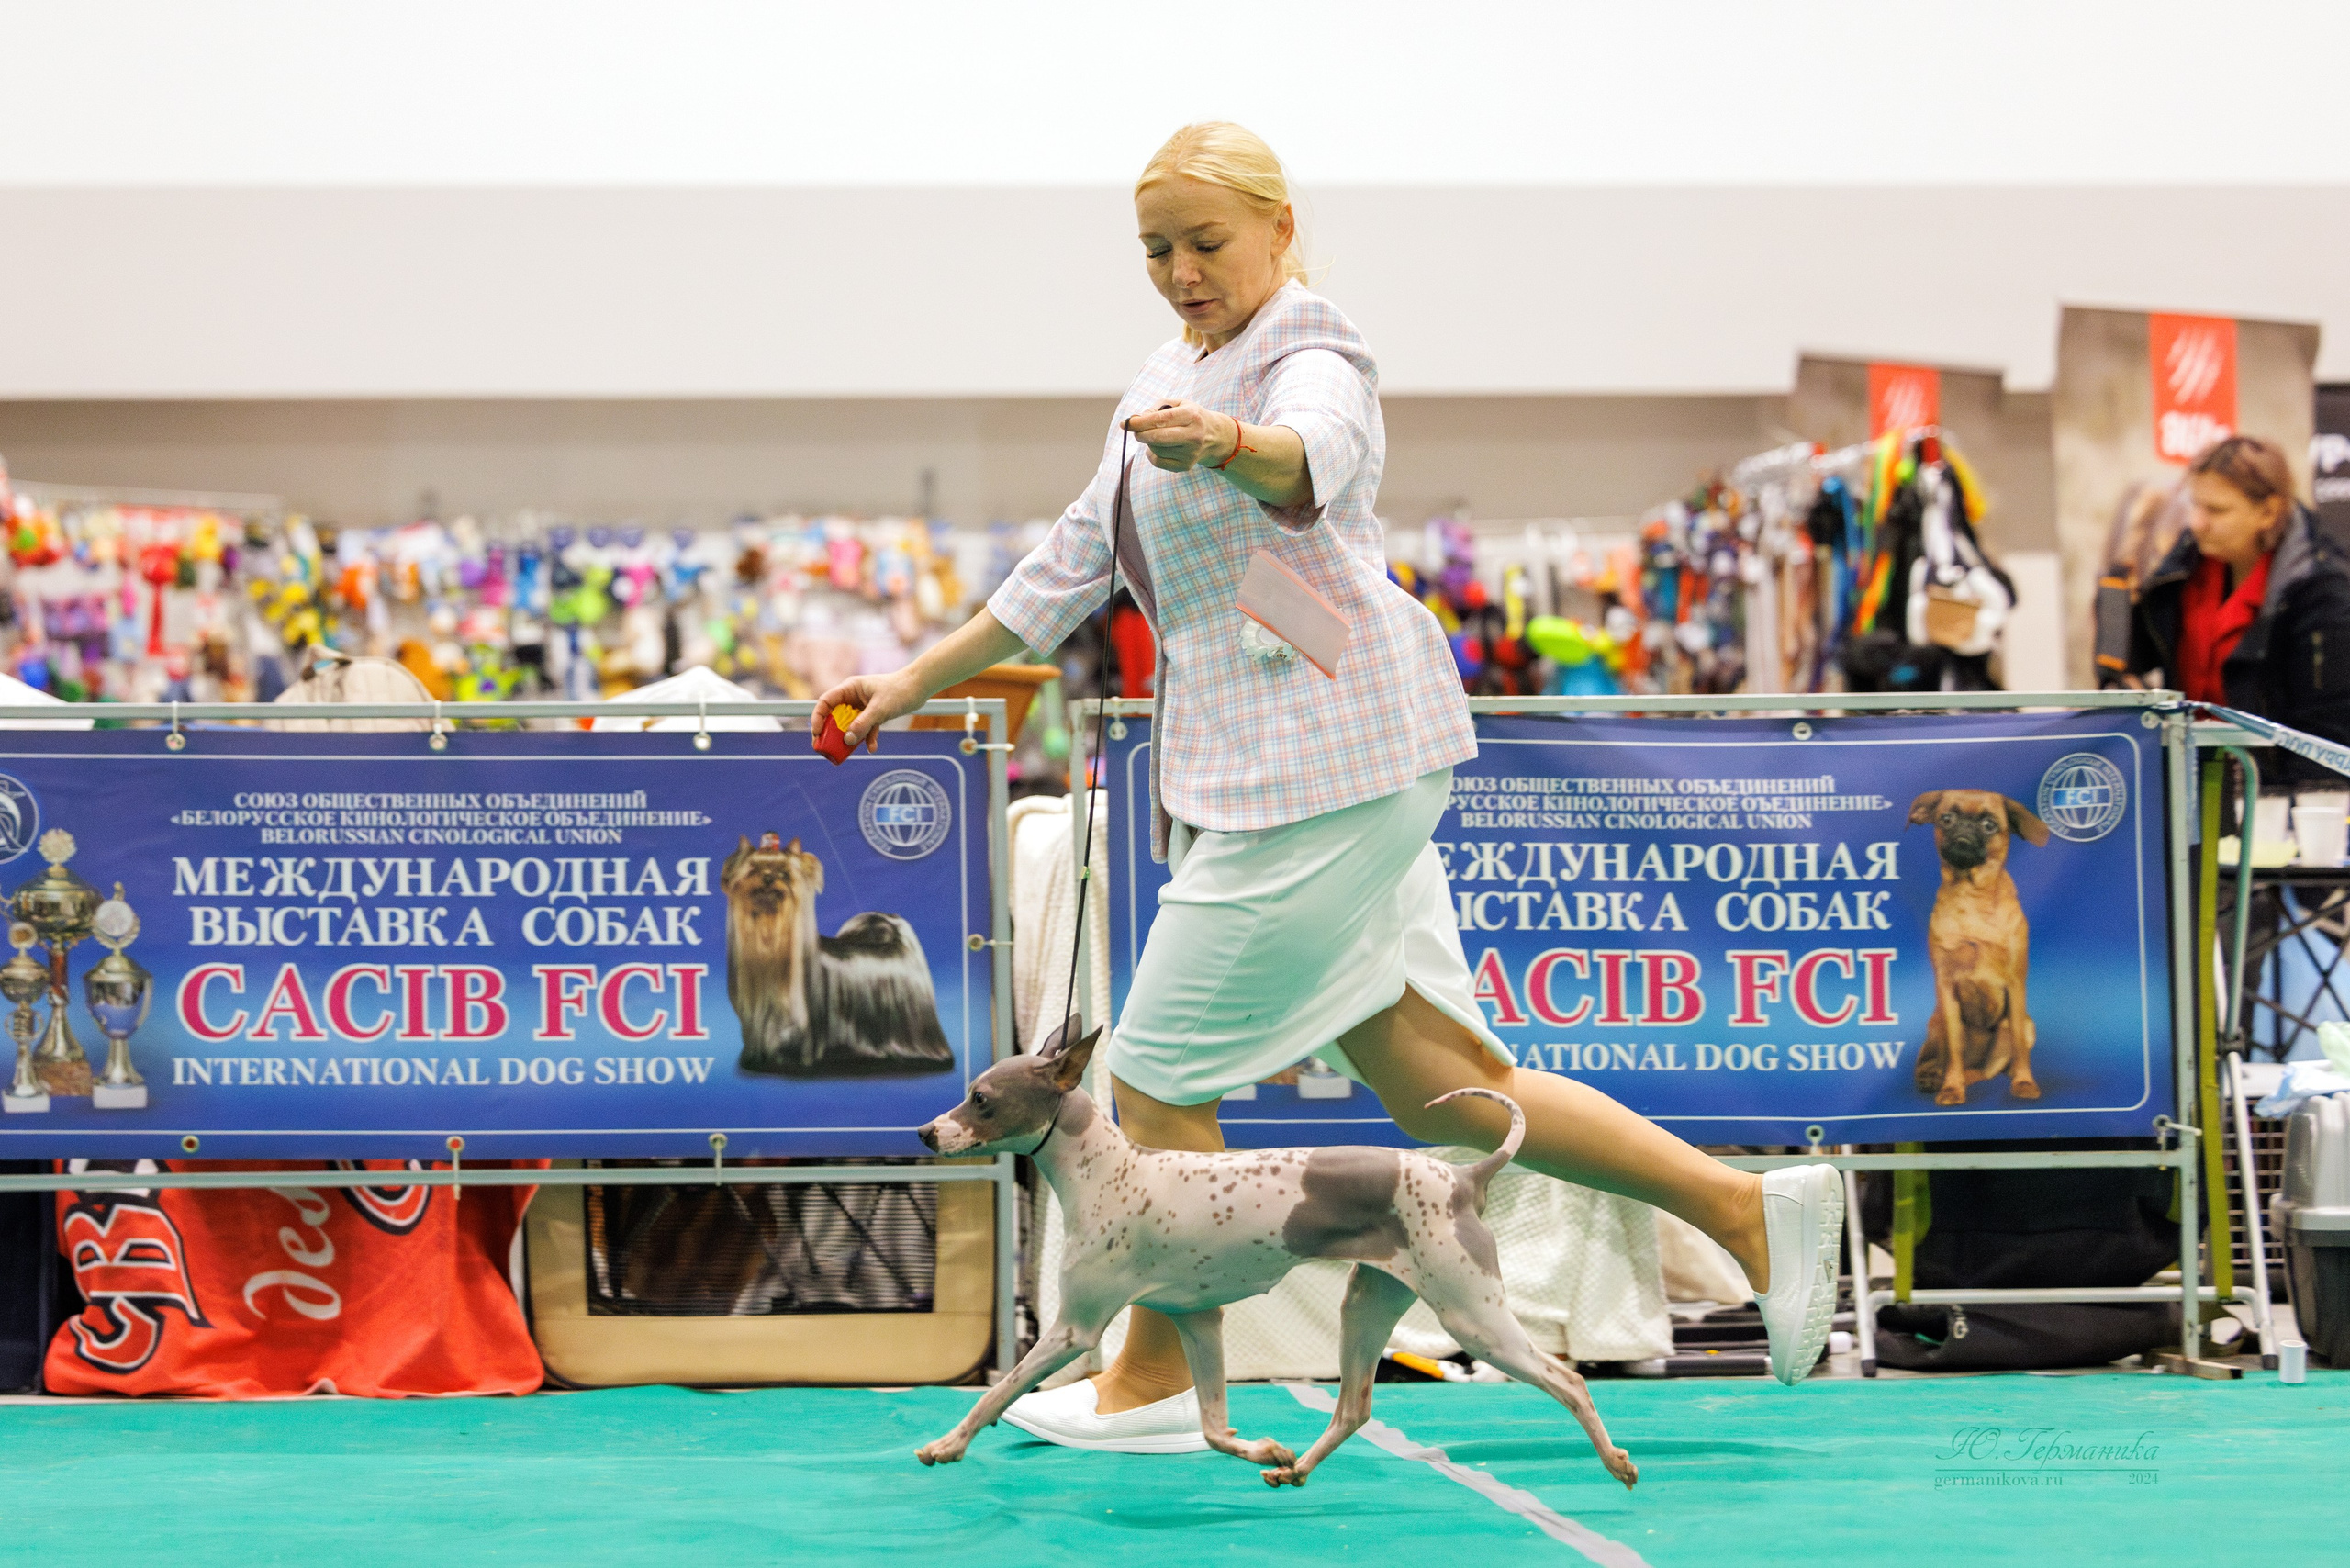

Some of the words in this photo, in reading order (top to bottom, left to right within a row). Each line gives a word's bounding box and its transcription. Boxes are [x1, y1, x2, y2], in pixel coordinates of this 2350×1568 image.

[1451, 777, 1497, 793] ОЮЗ
[1501, 778, 1676, 796] ОБЩЕСТВЕННЫХ
[1678, 775, 1835, 796] ОБЪЕДИНЕНИЙ
[2066, 789, 2099, 805] FCI
[234, 792, 298, 809] СОЮЗ
[301, 792, 482, 811] ОБЩЕСТВЕННЫХ
[485, 790, 648, 811] ОБЪЕДИНЕНИЙ
[1445, 795, 1539, 812] РУССКОЕ
[1542, 796, 1740, 812] КИНОЛОГИЧЕСКОЕ
[340, 811, 543, 827] КИНОЛОГИЧЕСКОЕ
[890, 808, 923, 823] FCI
[1460, 812, 1601, 829] BELORUSSIAN
[1604, 813, 1744, 830] CINOLOGICAL
[1747, 813, 1813, 829] UNION
[261, 828, 404, 845] BELORUSSIAN
[408, 828, 551, 845] CINOLOGICAL
[555, 828, 622, 845] UNION
[1435, 842, 1900, 890] ЕЖДУНАРОДНАЯ
[172, 857, 712, 904] МЕЖДУНАРОДНАЯ
[1715, 890, 1892, 933] СОБАК
[188, 905, 495, 946] ВЫСТАВКА
[521, 905, 702, 946] СОБАК
[1474, 947, 1706, 1028] ACIB
[1725, 947, 1898, 1028] FCI
[175, 962, 510, 1043] CACIB
[532, 961, 710, 1042] FCI
[1695, 1042, 1779, 1071] DOG
[1787, 1041, 1906, 1072] SHOW
[172, 1057, 490, 1086] INTERNATIONAL
[498, 1057, 586, 1086] DOG
[594, 1056, 715, 1085] SHOW
